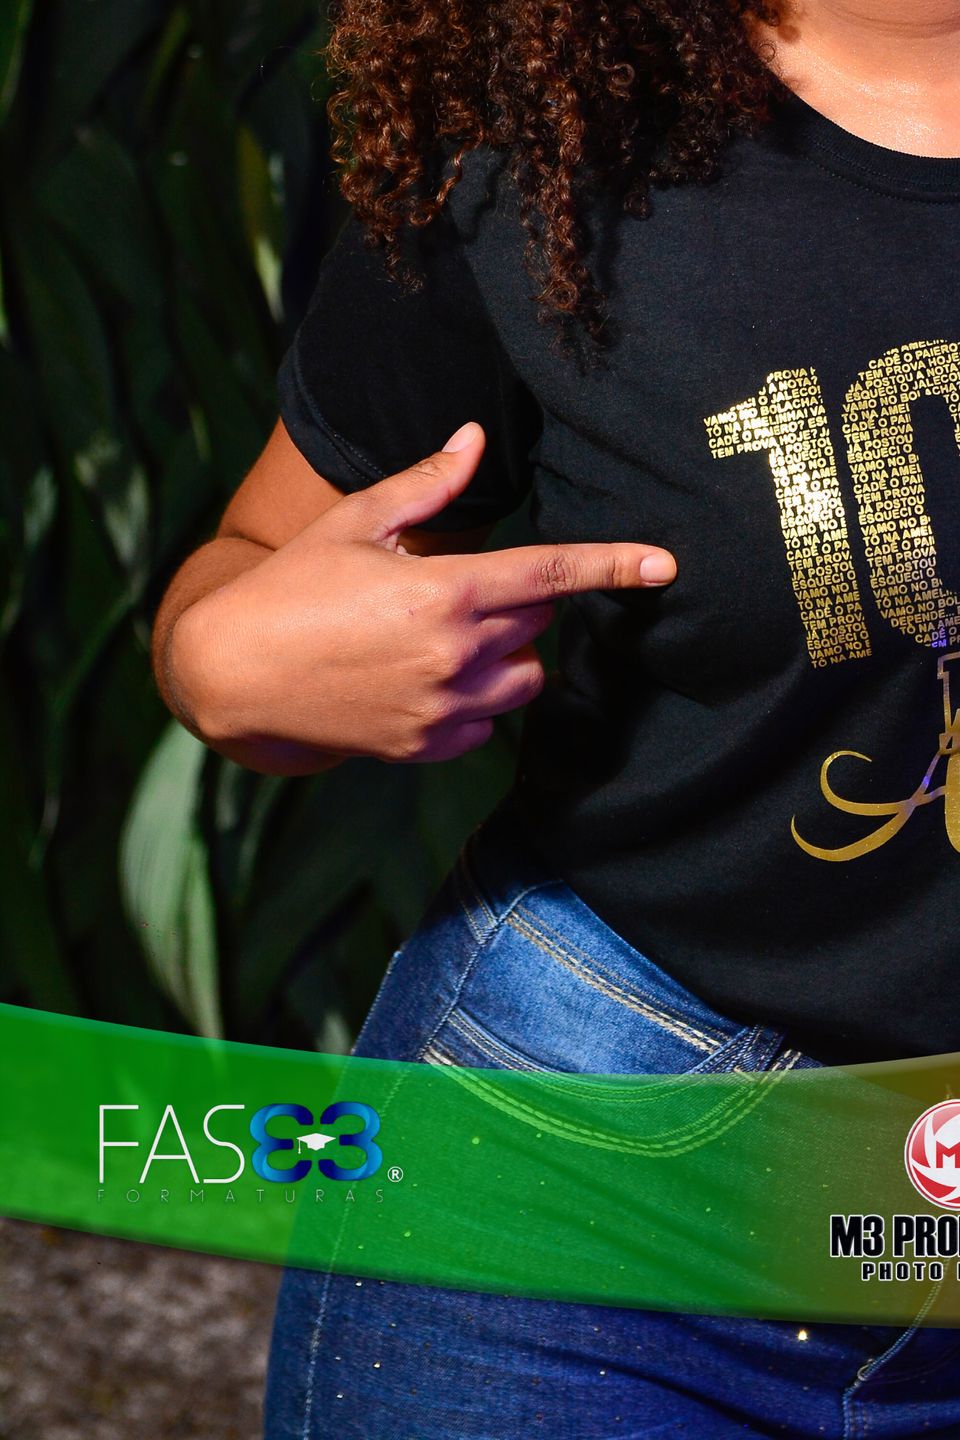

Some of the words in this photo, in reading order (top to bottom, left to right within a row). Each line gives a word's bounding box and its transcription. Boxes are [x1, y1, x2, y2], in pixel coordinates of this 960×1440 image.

[868, 353, 901, 369] CADÊ
[903, 352, 913, 362] O
[857, 368, 883, 381] TEM
[885, 360, 926, 376] PROVA
[845, 384, 897, 402] ESQUECI
[900, 382, 909, 392] O
[912, 371, 960, 390] JALECO!
[865, 372, 913, 389] POSTOU
[916, 370, 924, 379] A
[842, 398, 877, 413] VAMO
[879, 395, 897, 406] NO
[943, 390, 959, 403] TÔ
[841, 410, 858, 423] TÔ
[861, 409, 878, 420] NA
[842, 417, 875, 434] CADÊ
[878, 417, 887, 427] O
[784, 536, 800, 550] TÔ
[802, 534, 820, 546] NA
[786, 544, 819, 561] CADÊ
[821, 543, 831, 554] O
[788, 558, 813, 571] TEM
[792, 572, 844, 590] ESQUECI
[846, 570, 856, 580] O
[794, 586, 828, 600] VAMO
[831, 582, 849, 594] NO
[797, 598, 813, 610] TÔ
[816, 596, 833, 607] NA
[880, 605, 914, 618] VAMO
[917, 600, 935, 612] NO
[800, 605, 832, 620] CADÊ
[834, 605, 843, 615] O
[803, 619, 826, 630] TEM
[899, 621, 916, 634] TÔ
[918, 622, 935, 633] NA
[806, 632, 857, 650] ESQUECI
[859, 630, 869, 639] O
[914, 625, 946, 643] CADÊ
[948, 626, 957, 635] O
[808, 645, 842, 659] VAMO
[844, 641, 862, 650] NO
[811, 655, 827, 668] TÔ
[830, 654, 846, 664] NA
